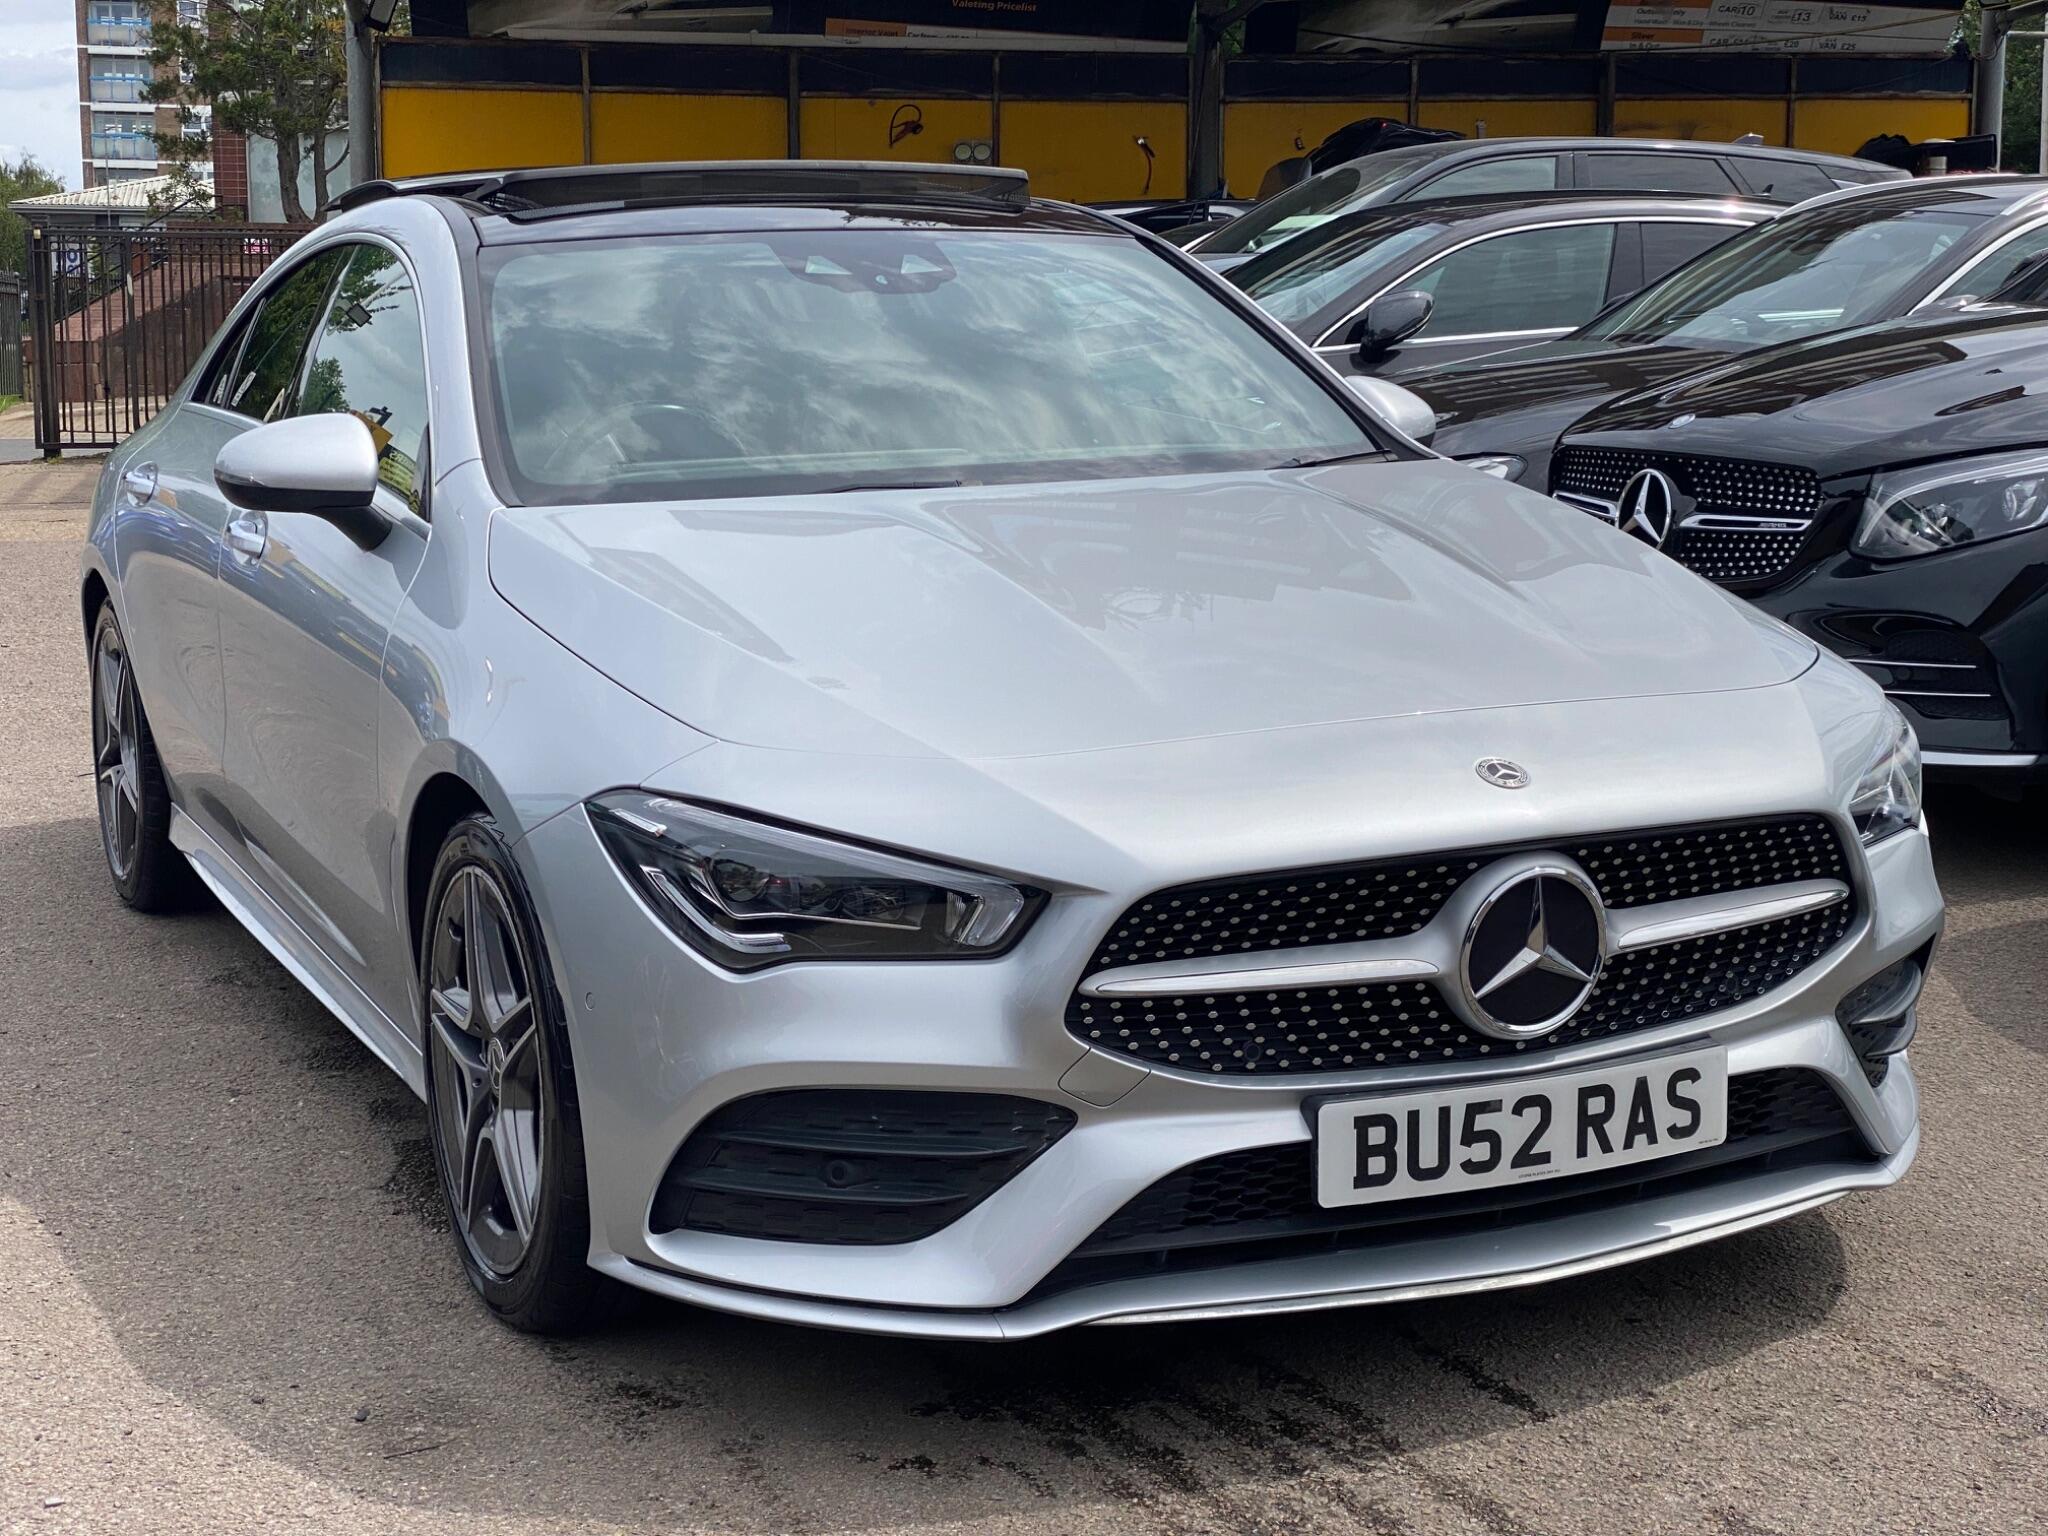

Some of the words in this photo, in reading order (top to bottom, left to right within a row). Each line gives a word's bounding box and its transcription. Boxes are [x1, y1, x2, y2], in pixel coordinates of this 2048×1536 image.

[952, 0, 995, 11] Valeting
[996, 0, 1037, 12] Pricelist
[1353, 1094, 1552, 1190] BU52
[1576, 1066, 1702, 1159] RAS
